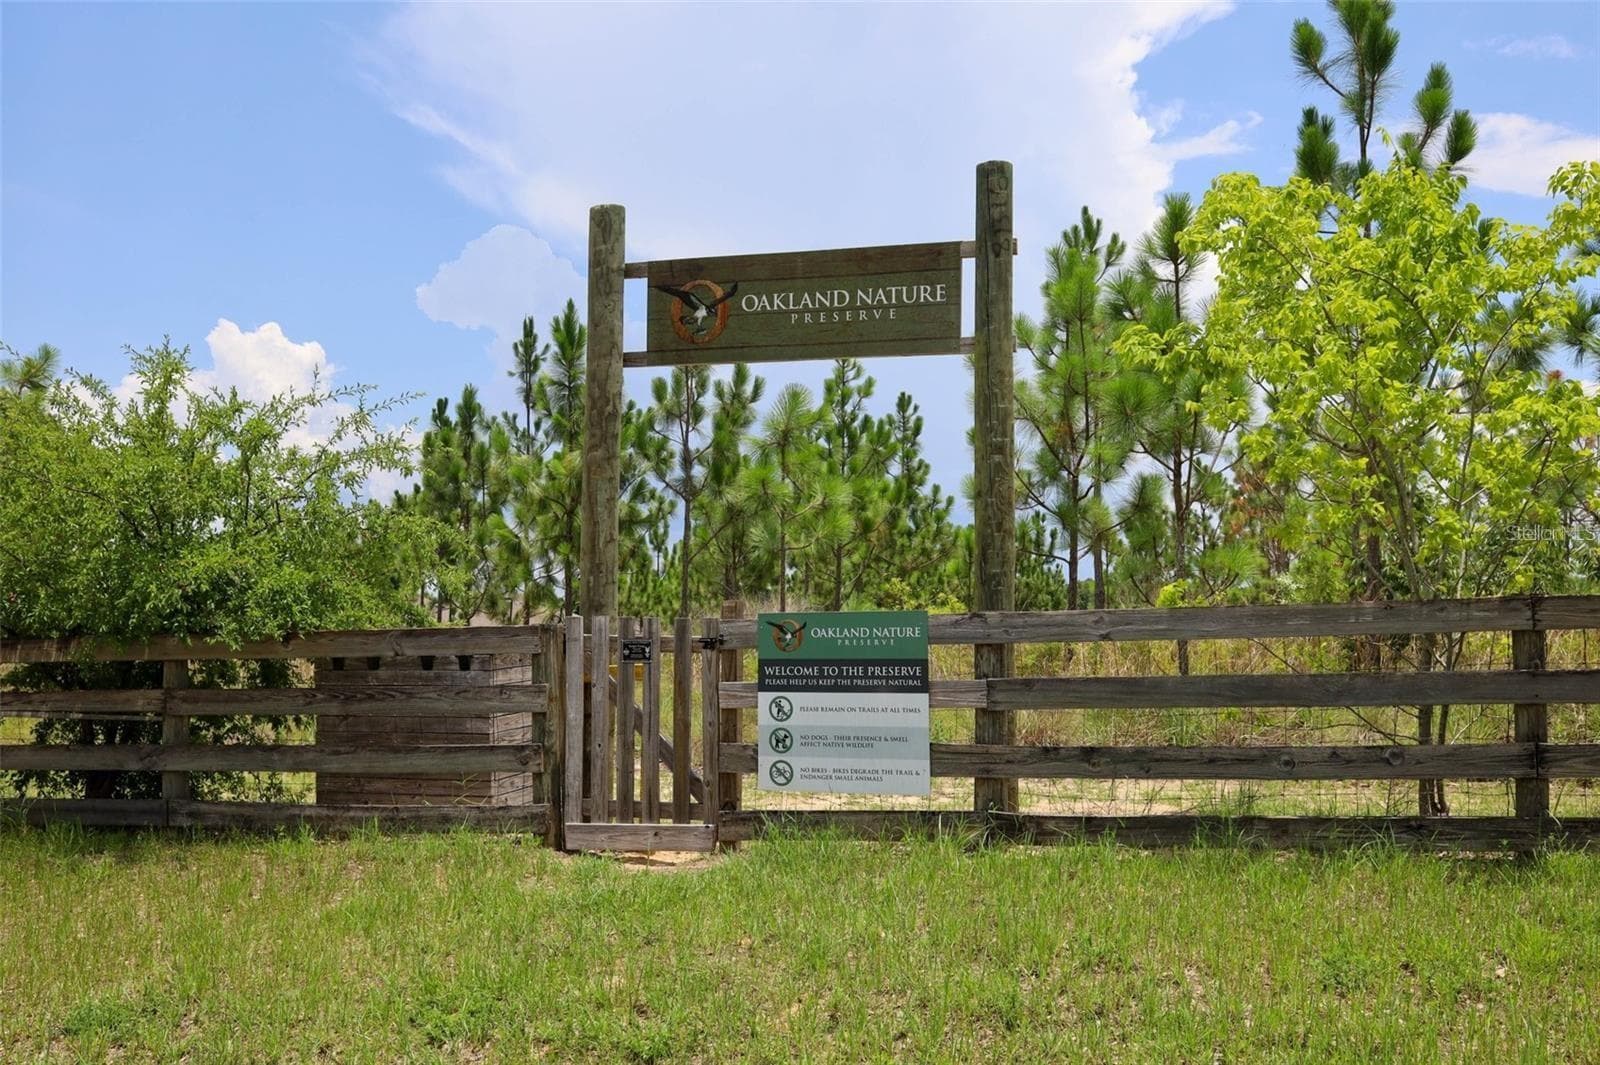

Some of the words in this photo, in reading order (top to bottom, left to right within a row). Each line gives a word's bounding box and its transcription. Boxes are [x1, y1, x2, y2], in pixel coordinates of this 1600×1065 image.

[742, 289, 850, 312] OAKLAND
[856, 284, 946, 306] NATURE
[791, 308, 897, 324] PRESERVE
[810, 627, 870, 638] OAKLAND
[872, 626, 921, 638] NATURE
[764, 666, 819, 676] WELCOME
[822, 666, 838, 676] TO
[841, 666, 864, 676] THE
[868, 666, 922, 677] PRESERVE
[808, 678, 818, 686] US
[819, 678, 835, 686] KEEP
